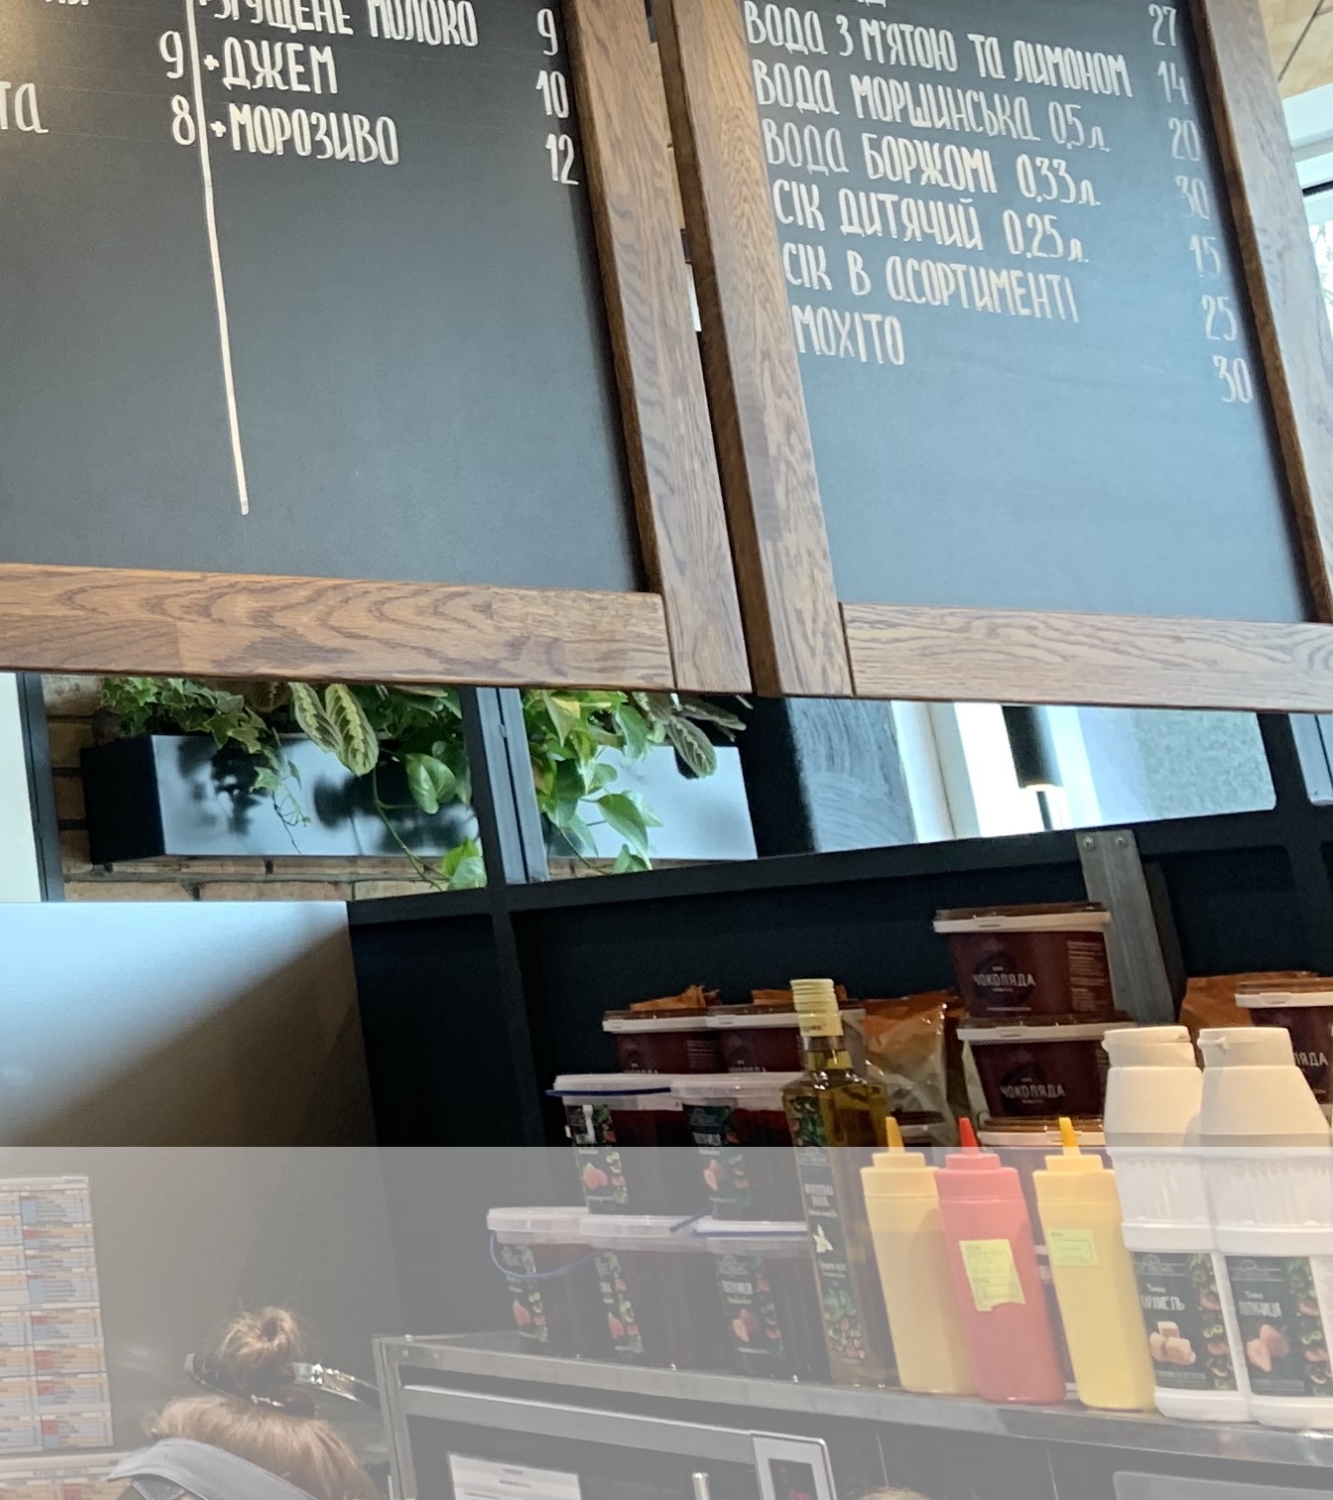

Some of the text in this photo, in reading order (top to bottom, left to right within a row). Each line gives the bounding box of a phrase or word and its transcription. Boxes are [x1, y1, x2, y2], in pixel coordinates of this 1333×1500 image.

[158, 30, 185, 80] 9
[537, 7, 559, 56] 9
[744, 0, 828, 56] ВОДА
[967, 31, 1006, 79] ТА
[1014, 39, 1134, 98] ЛИМОНОМ
[1156, 61, 1190, 105] 14
[1148, 3, 1178, 48] 27
[170, 94, 196, 146] 8
[535, 70, 569, 119] 10
[751, 58, 1201, 162] ВОДА МОРШИНСЬКА 20
[544, 133, 579, 186] 12
[761, 118, 1210, 220] ВОДА БОРЖОМІ 30
[772, 178, 1222, 280] СІК ДИТЯЧИЙ 15
[782, 241, 1238, 342] СІК В АСОРТИМЕНТІ 25
[791, 304, 1254, 405] МОХІТО 30
